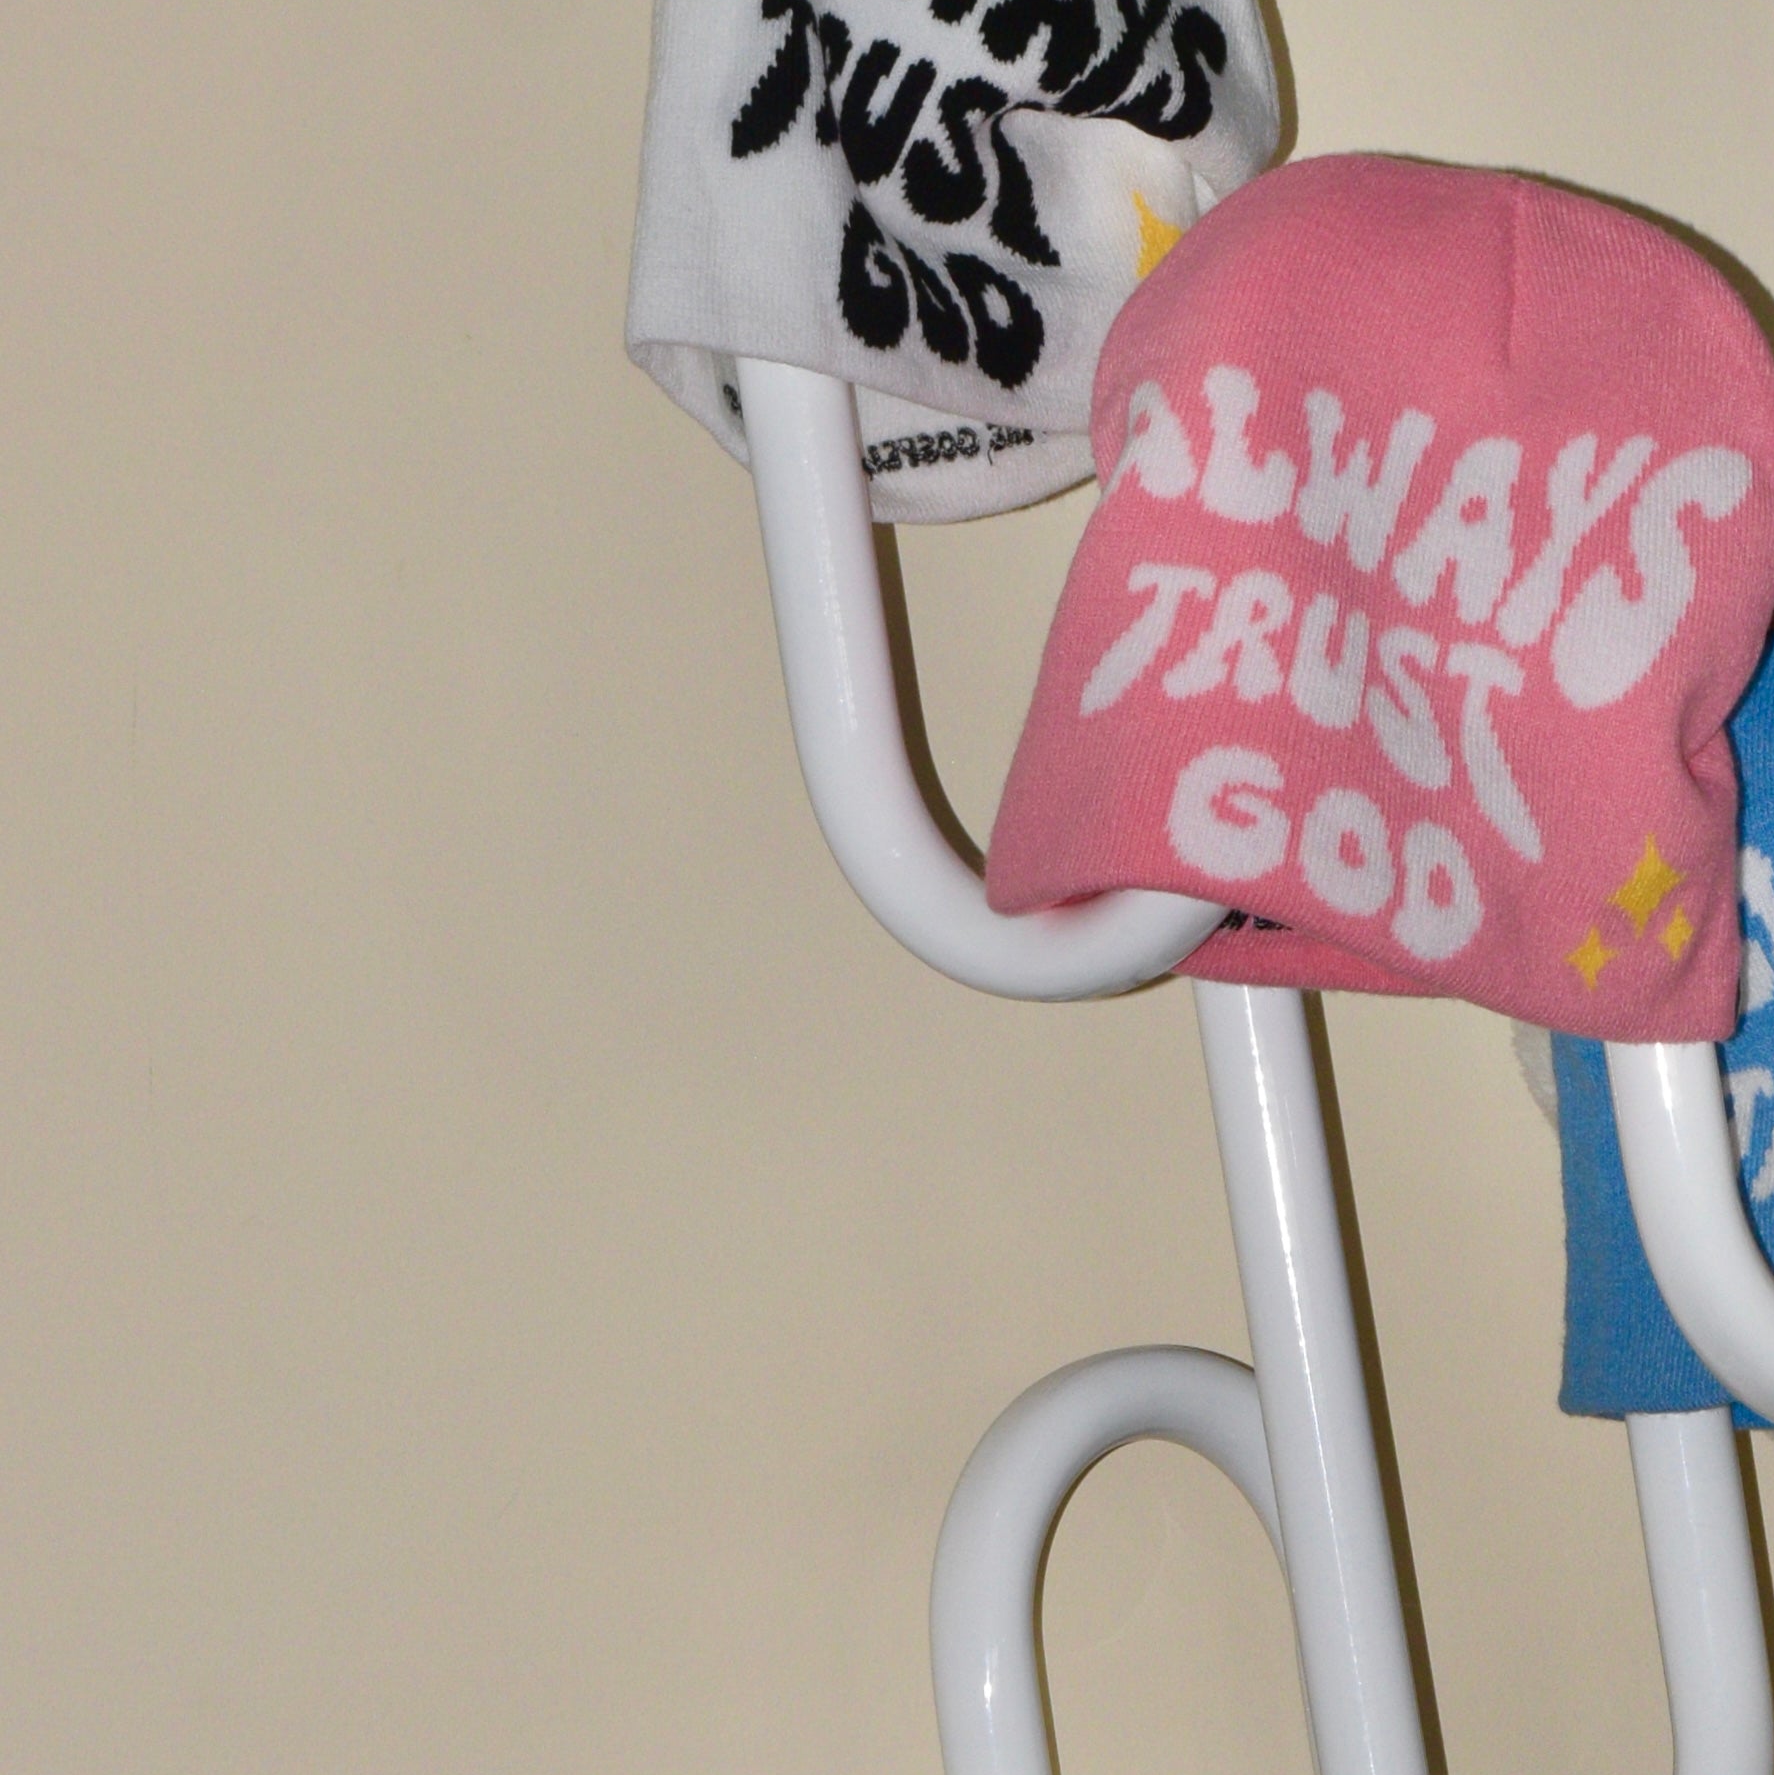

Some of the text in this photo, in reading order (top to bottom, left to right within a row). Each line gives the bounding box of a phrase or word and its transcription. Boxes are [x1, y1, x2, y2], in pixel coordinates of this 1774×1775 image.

[1104, 365, 1753, 711] ALWAYS
[1080, 562, 1544, 864] TRUST
[1167, 746, 1484, 962] GOD
